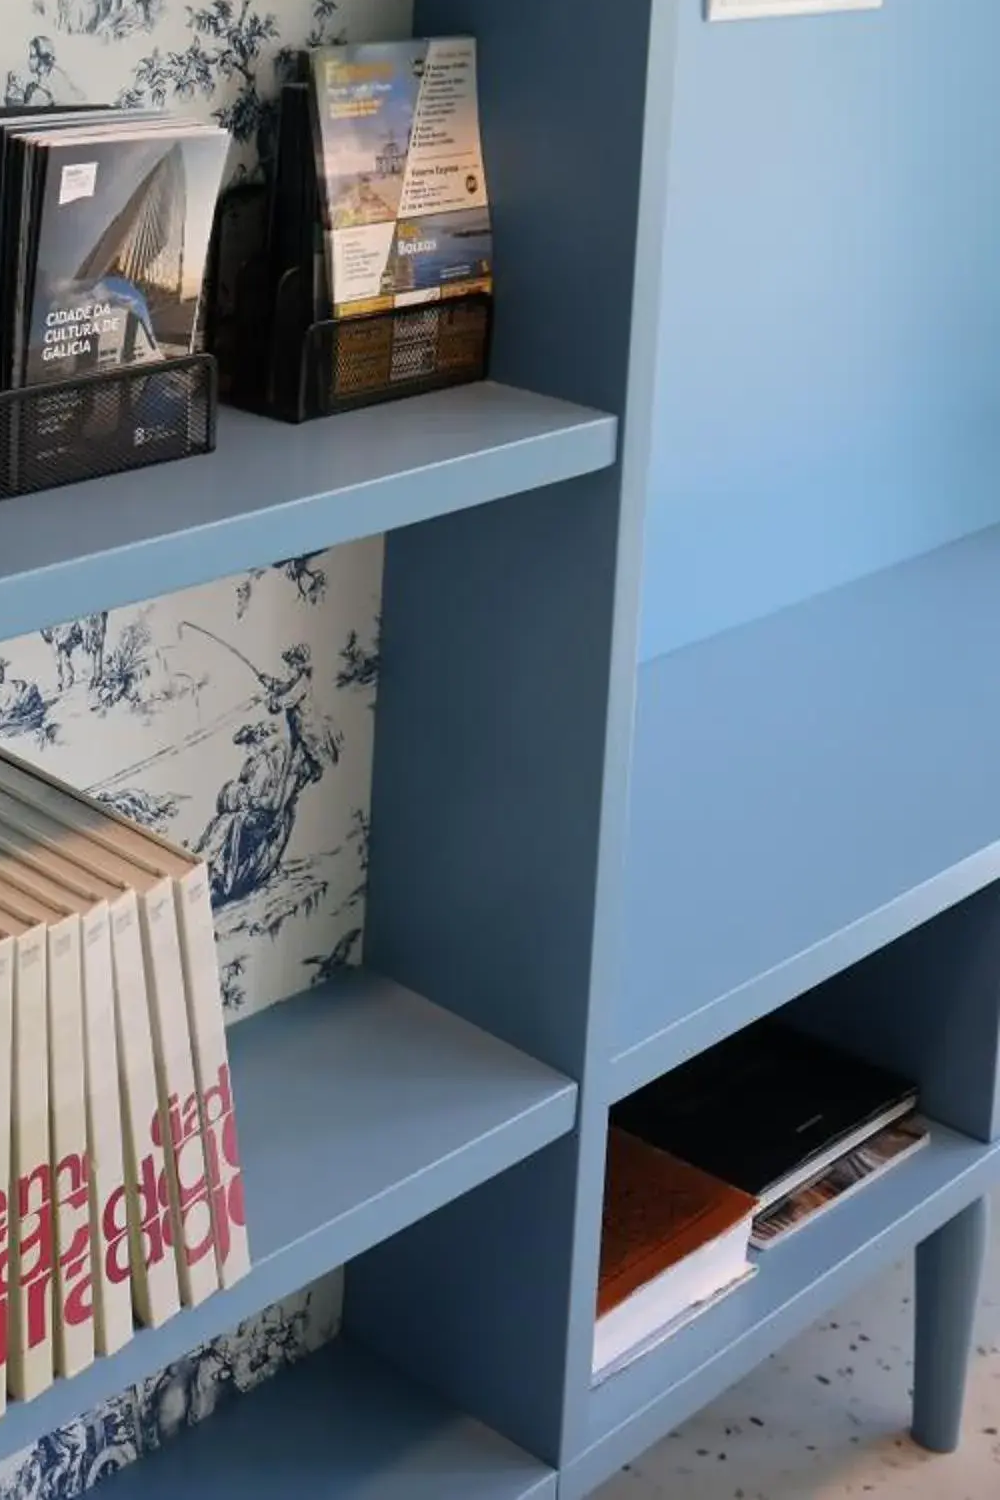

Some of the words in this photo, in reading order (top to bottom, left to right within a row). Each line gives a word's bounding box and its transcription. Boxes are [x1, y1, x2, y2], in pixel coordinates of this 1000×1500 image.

[46, 305, 92, 327] CIDADE
[93, 303, 112, 318] DA
[44, 320, 100, 344] CULTURA
[102, 317, 121, 333] DE
[42, 339, 92, 361] GALICIA
